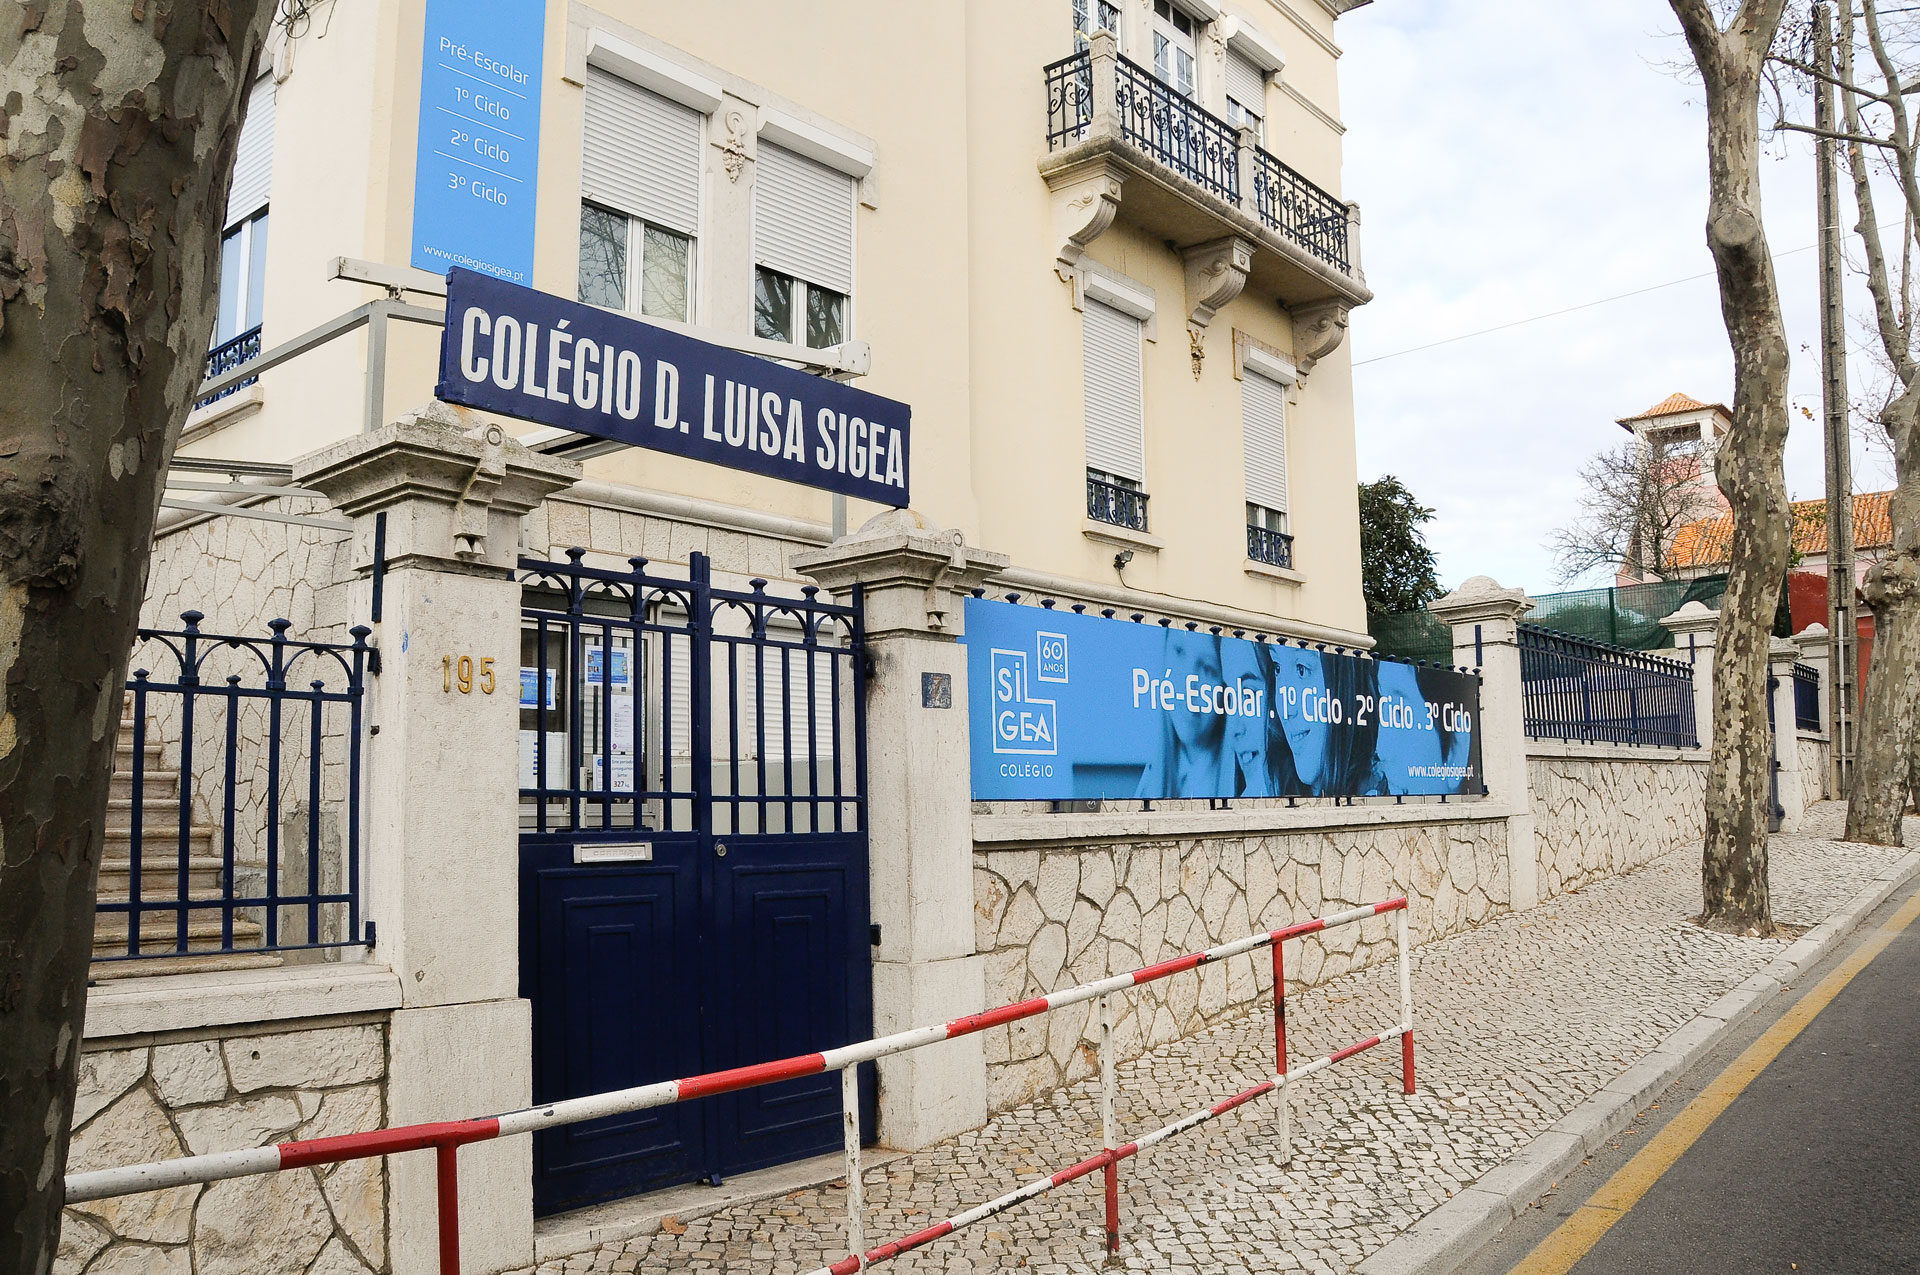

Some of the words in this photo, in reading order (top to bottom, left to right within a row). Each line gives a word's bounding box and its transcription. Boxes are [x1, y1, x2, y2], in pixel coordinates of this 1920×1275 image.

[439, 36, 529, 86] Pré-Escolar
[454, 87, 469, 102] 1º
[474, 94, 510, 120] Ciclo
[450, 129, 469, 146] 2º
[474, 137, 510, 163] Ciclo
[448, 173, 466, 190] 3º
[471, 180, 508, 206] Ciclo
[423, 244, 524, 282] www.colegiosigea.pt
[460, 306, 641, 420] COLÉGIO
[654, 359, 690, 434] D.
[702, 374, 806, 464] LUISA
[816, 407, 905, 489] SIGEA
[1042, 640, 1063, 660] 60
[442, 654, 496, 695] 195
[1043, 662, 1064, 673] ANOS
[1132, 668, 1263, 718] Pré-Escolar
[1279, 686, 1296, 720] 1º
[1302, 686, 1343, 725] Ciclo
[1356, 694, 1374, 727] 2º
[1378, 695, 1414, 730] Ciclo
[1424, 702, 1439, 731] 3º
[1442, 702, 1471, 733] Ciclo
[998, 710, 1052, 742] GEA
[613, 780, 625, 788] 327
[1000, 761, 1054, 777] COLÉGIO
[1408, 763, 1474, 781] www.colegiosigea.pt
